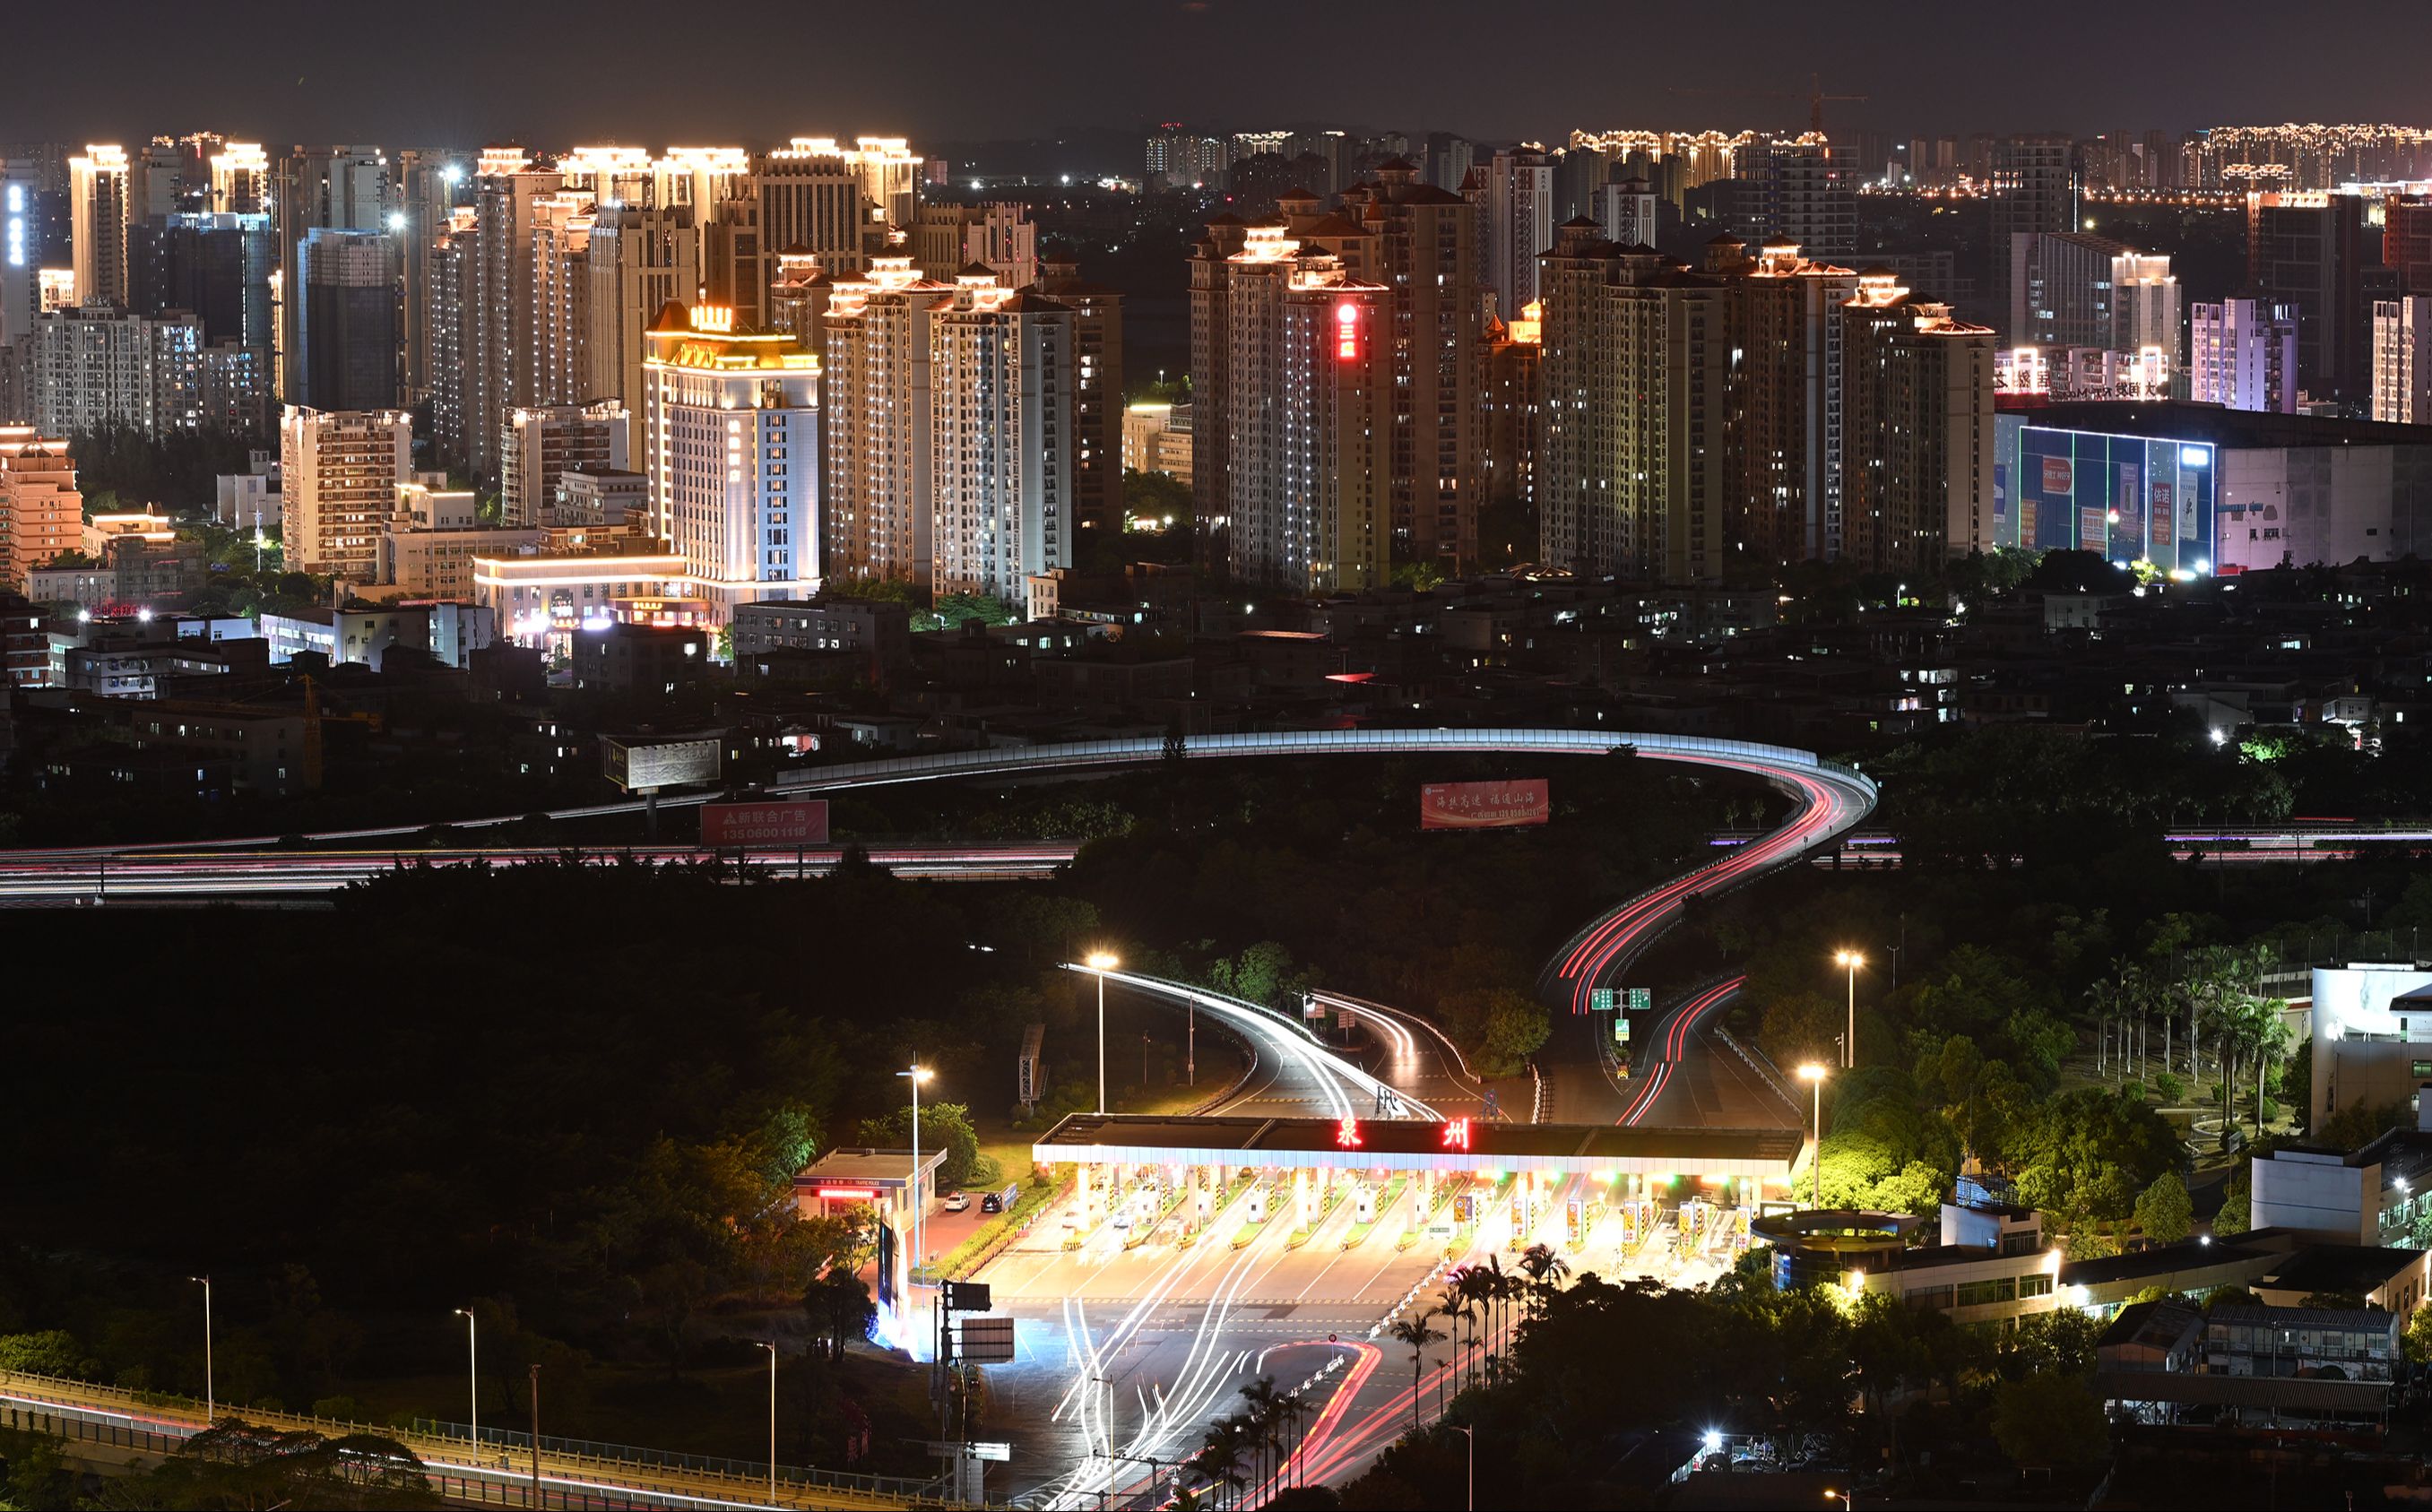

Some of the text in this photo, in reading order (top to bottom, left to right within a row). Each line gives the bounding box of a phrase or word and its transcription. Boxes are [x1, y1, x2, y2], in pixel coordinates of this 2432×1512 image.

[2154, 488, 2169, 504] 依诺
[739, 809, 806, 824] 新联合广告
